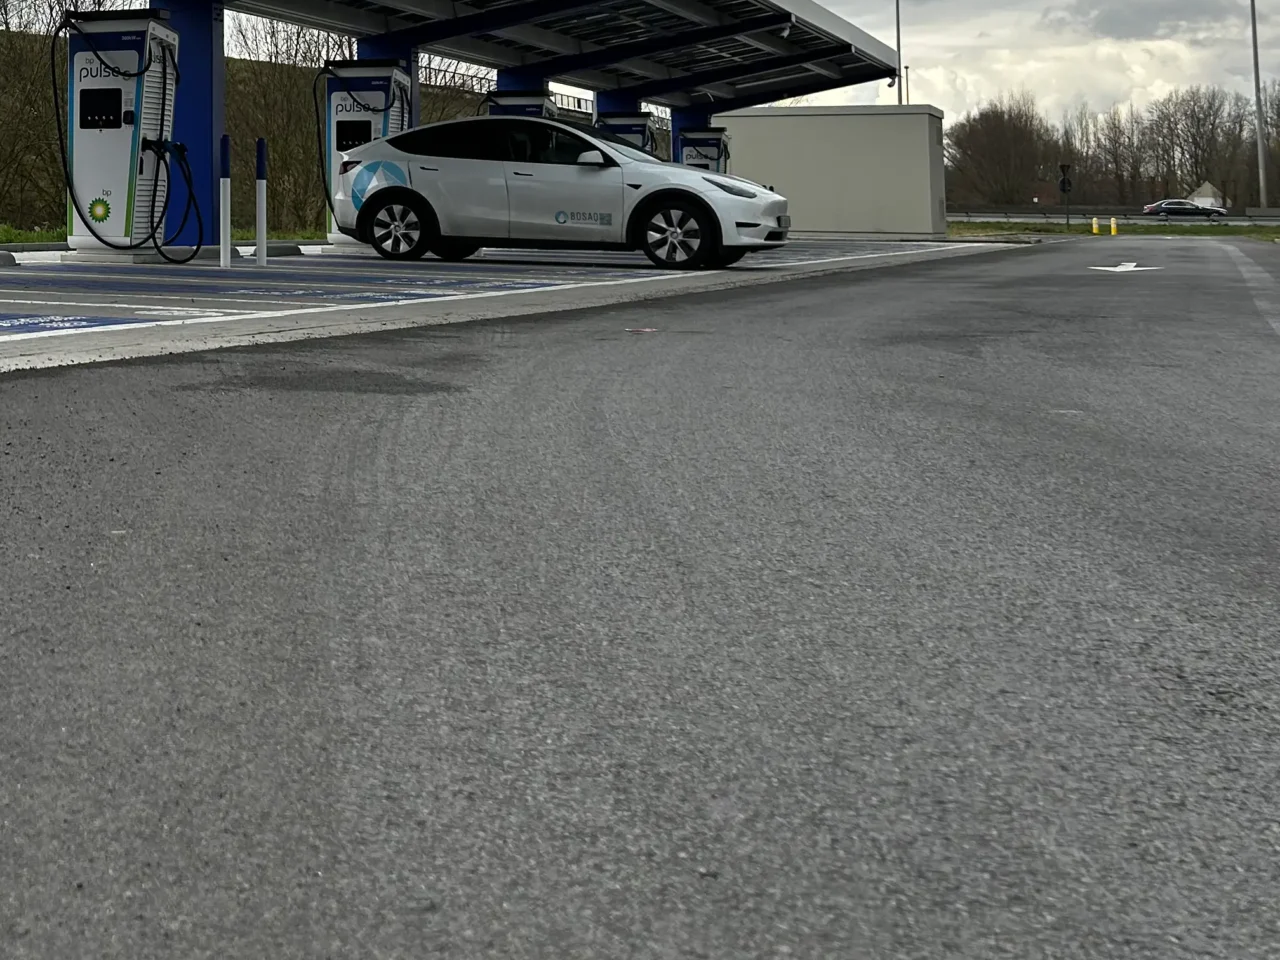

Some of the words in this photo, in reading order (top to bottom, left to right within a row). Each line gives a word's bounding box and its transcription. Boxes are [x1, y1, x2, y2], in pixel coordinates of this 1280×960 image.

[85, 57, 95, 65] bp
[79, 61, 120, 82] pulse
[335, 100, 370, 115] pulse
[102, 189, 112, 197] bp
[570, 211, 599, 222] BOSAQ
